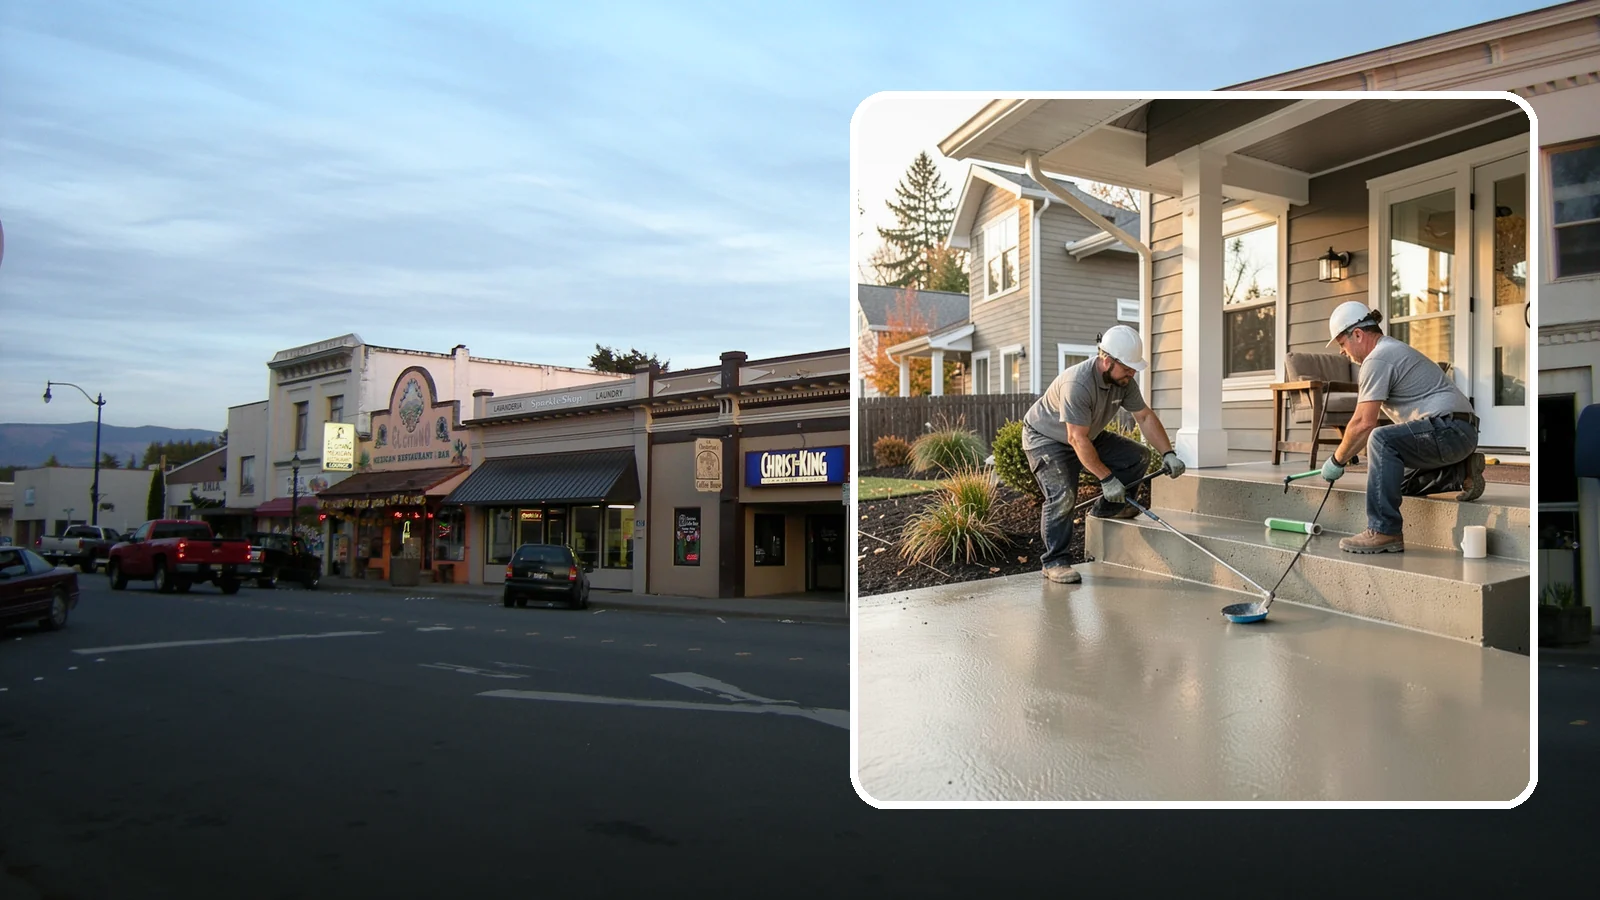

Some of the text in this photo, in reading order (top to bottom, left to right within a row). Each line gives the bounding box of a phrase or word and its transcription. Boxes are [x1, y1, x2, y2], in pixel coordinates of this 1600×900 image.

[531, 394, 582, 408] Sparkle Shop
[595, 389, 623, 400] LAUNDRY
[494, 402, 522, 412] LAVANDERIA
[374, 455, 396, 464] MEXICAN
[398, 452, 433, 462] RESTAURANT
[438, 450, 450, 458] BAR
[761, 450, 827, 478] CHRIST KING
